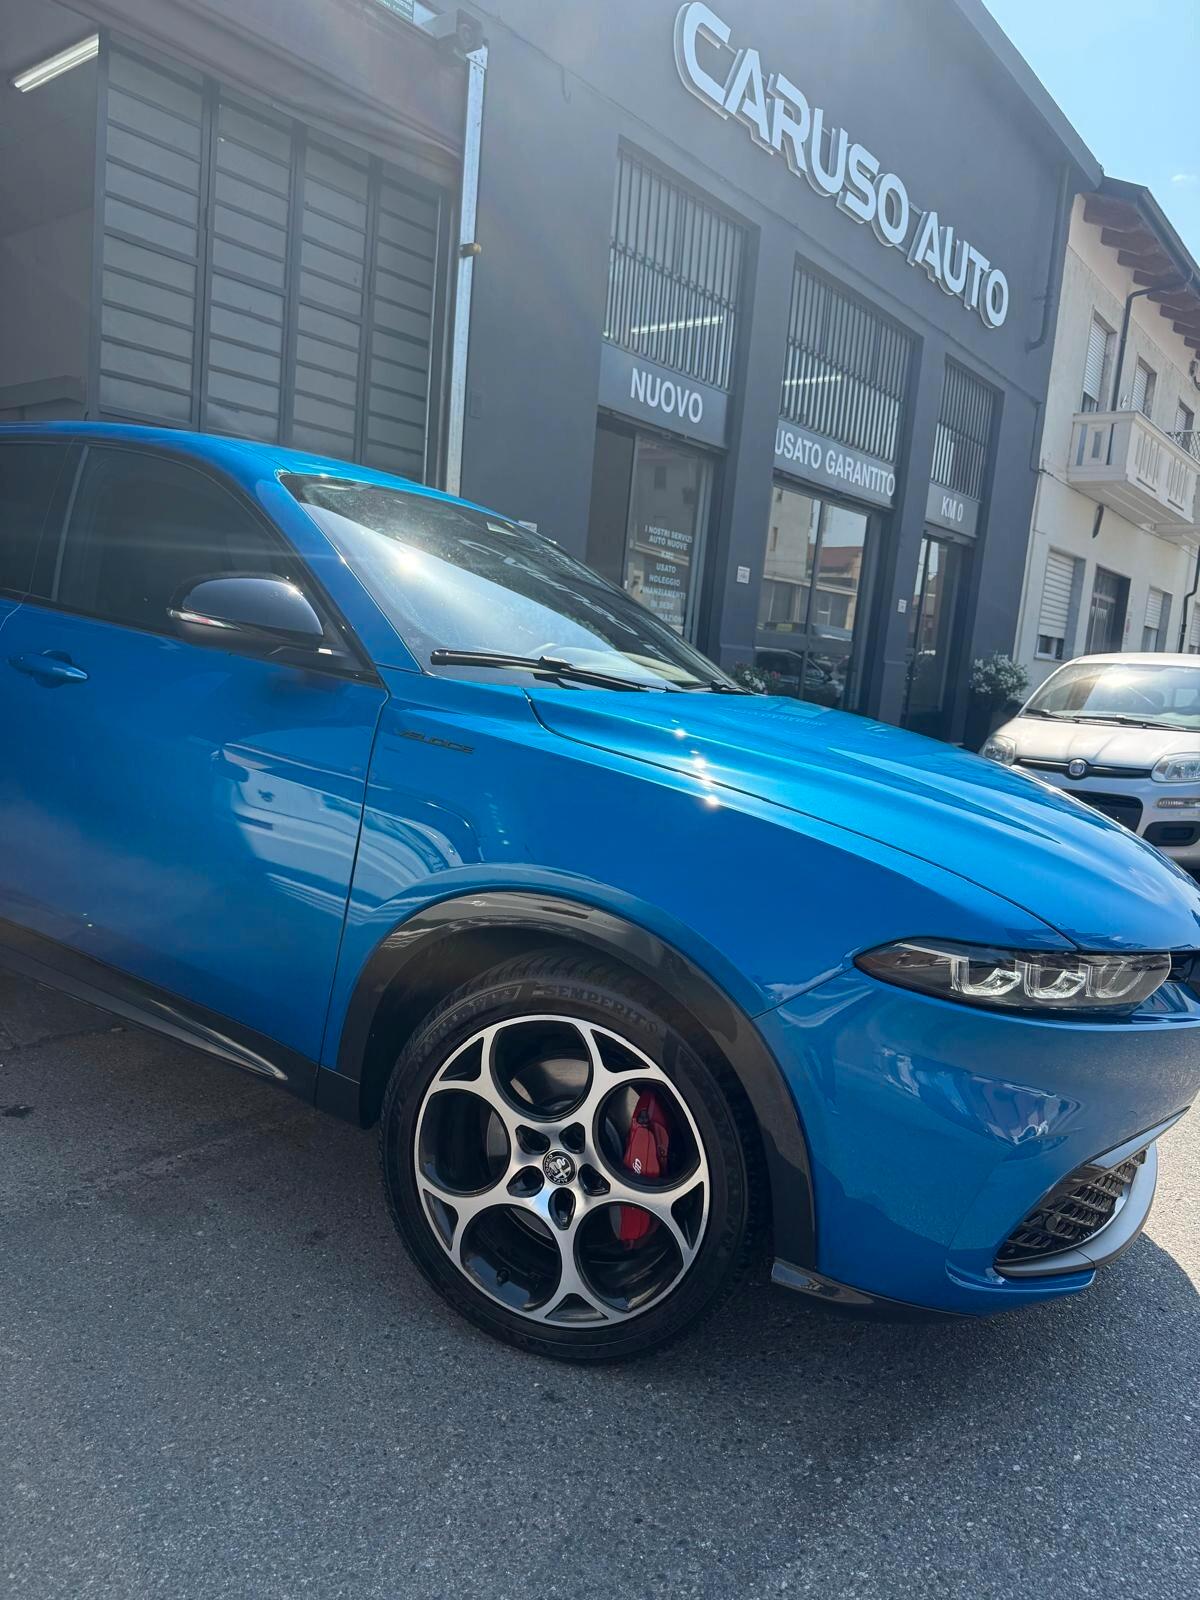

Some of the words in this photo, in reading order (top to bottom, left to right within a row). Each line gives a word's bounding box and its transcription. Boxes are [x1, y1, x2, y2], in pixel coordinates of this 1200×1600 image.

[674, 0, 909, 247] CARUSO
[907, 211, 1009, 328] AUTO
[630, 367, 703, 424] NUOVO
[774, 428, 822, 470] USATO
[825, 449, 896, 497] GARANTITO
[941, 496, 957, 520] KM
[957, 503, 964, 522] 0
[648, 526, 671, 538] NOSTRI
[671, 531, 693, 544] SERVIZI
[648, 534, 666, 546] AUTO
[667, 539, 689, 551] NUOVE
[656, 562, 677, 574] USATO
[648, 574, 681, 587] NOLEGGIO
